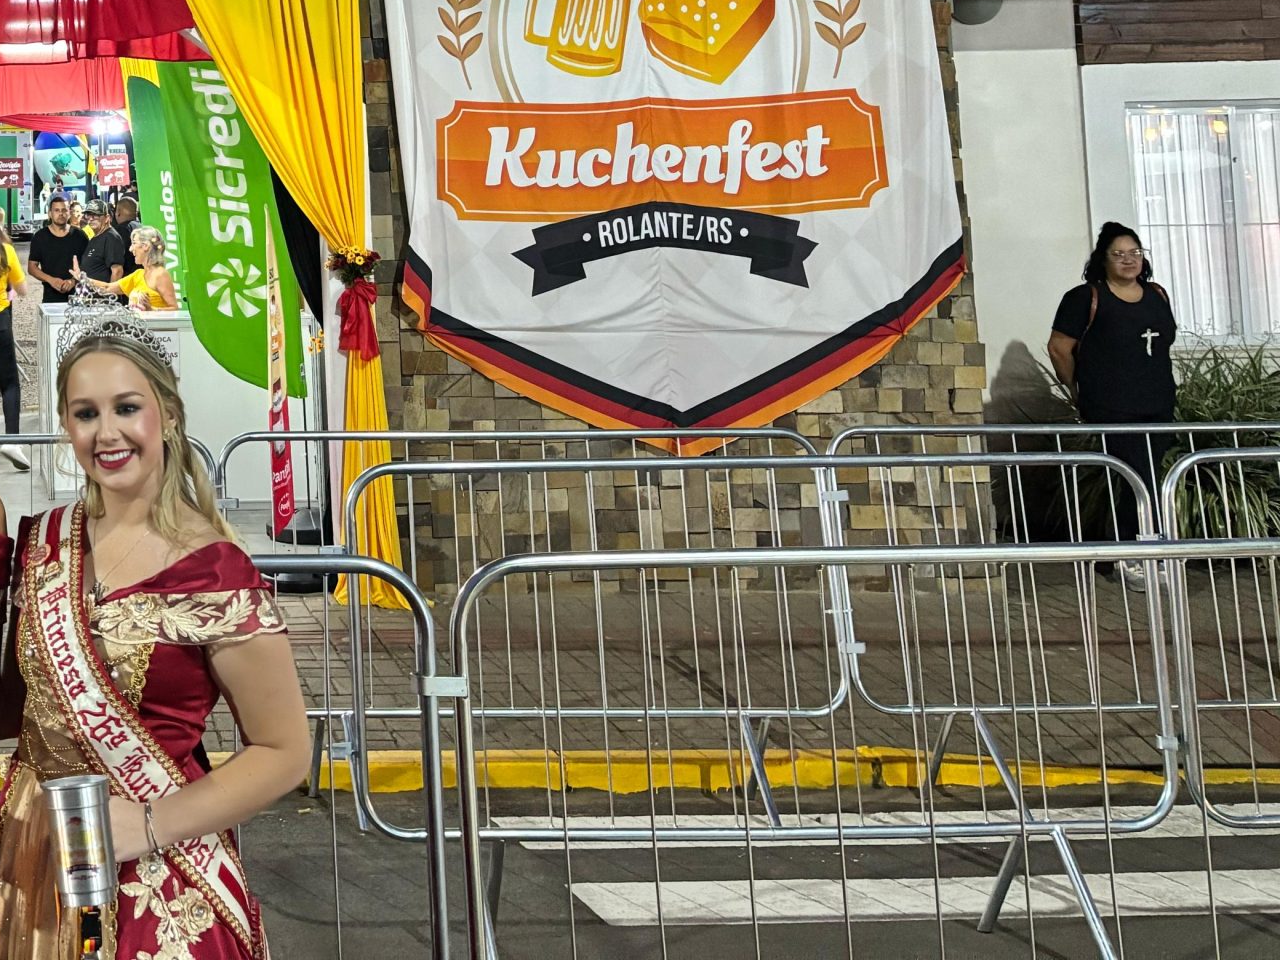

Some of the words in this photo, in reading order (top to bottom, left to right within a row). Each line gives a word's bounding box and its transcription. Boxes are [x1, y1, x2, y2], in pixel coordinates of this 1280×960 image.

[188, 66, 254, 247] Sicredi
[485, 119, 830, 194] Kuchenfest
[159, 170, 182, 308] -Vindos
[598, 211, 733, 247] ROLANTE/RS
[39, 581, 88, 700] Princesa
